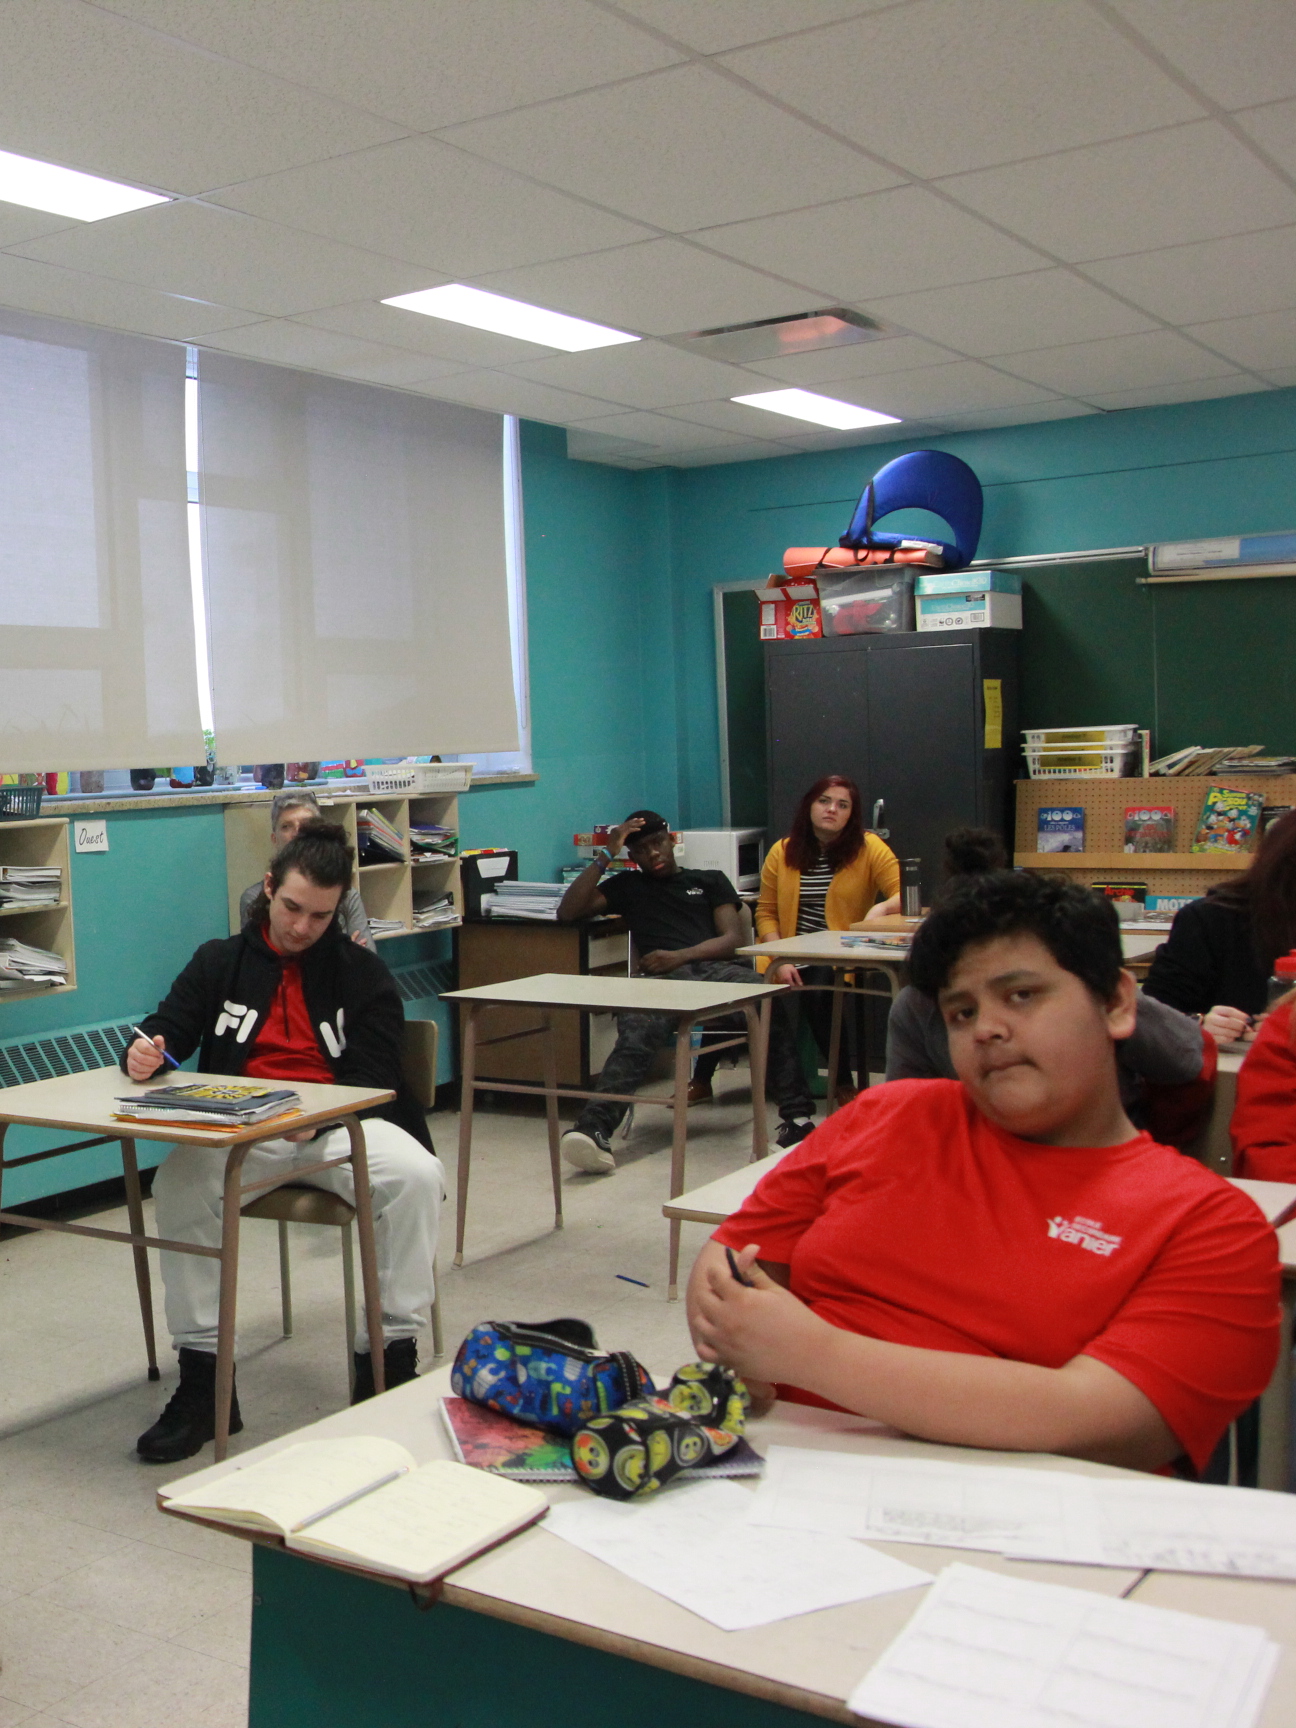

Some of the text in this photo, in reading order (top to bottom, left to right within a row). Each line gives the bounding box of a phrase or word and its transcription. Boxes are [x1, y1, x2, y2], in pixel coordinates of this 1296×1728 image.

[794, 604, 814, 622] RITZ
[1047, 810, 1073, 821] 100
[1134, 809, 1162, 821] 100
[79, 828, 104, 845] Ouest
